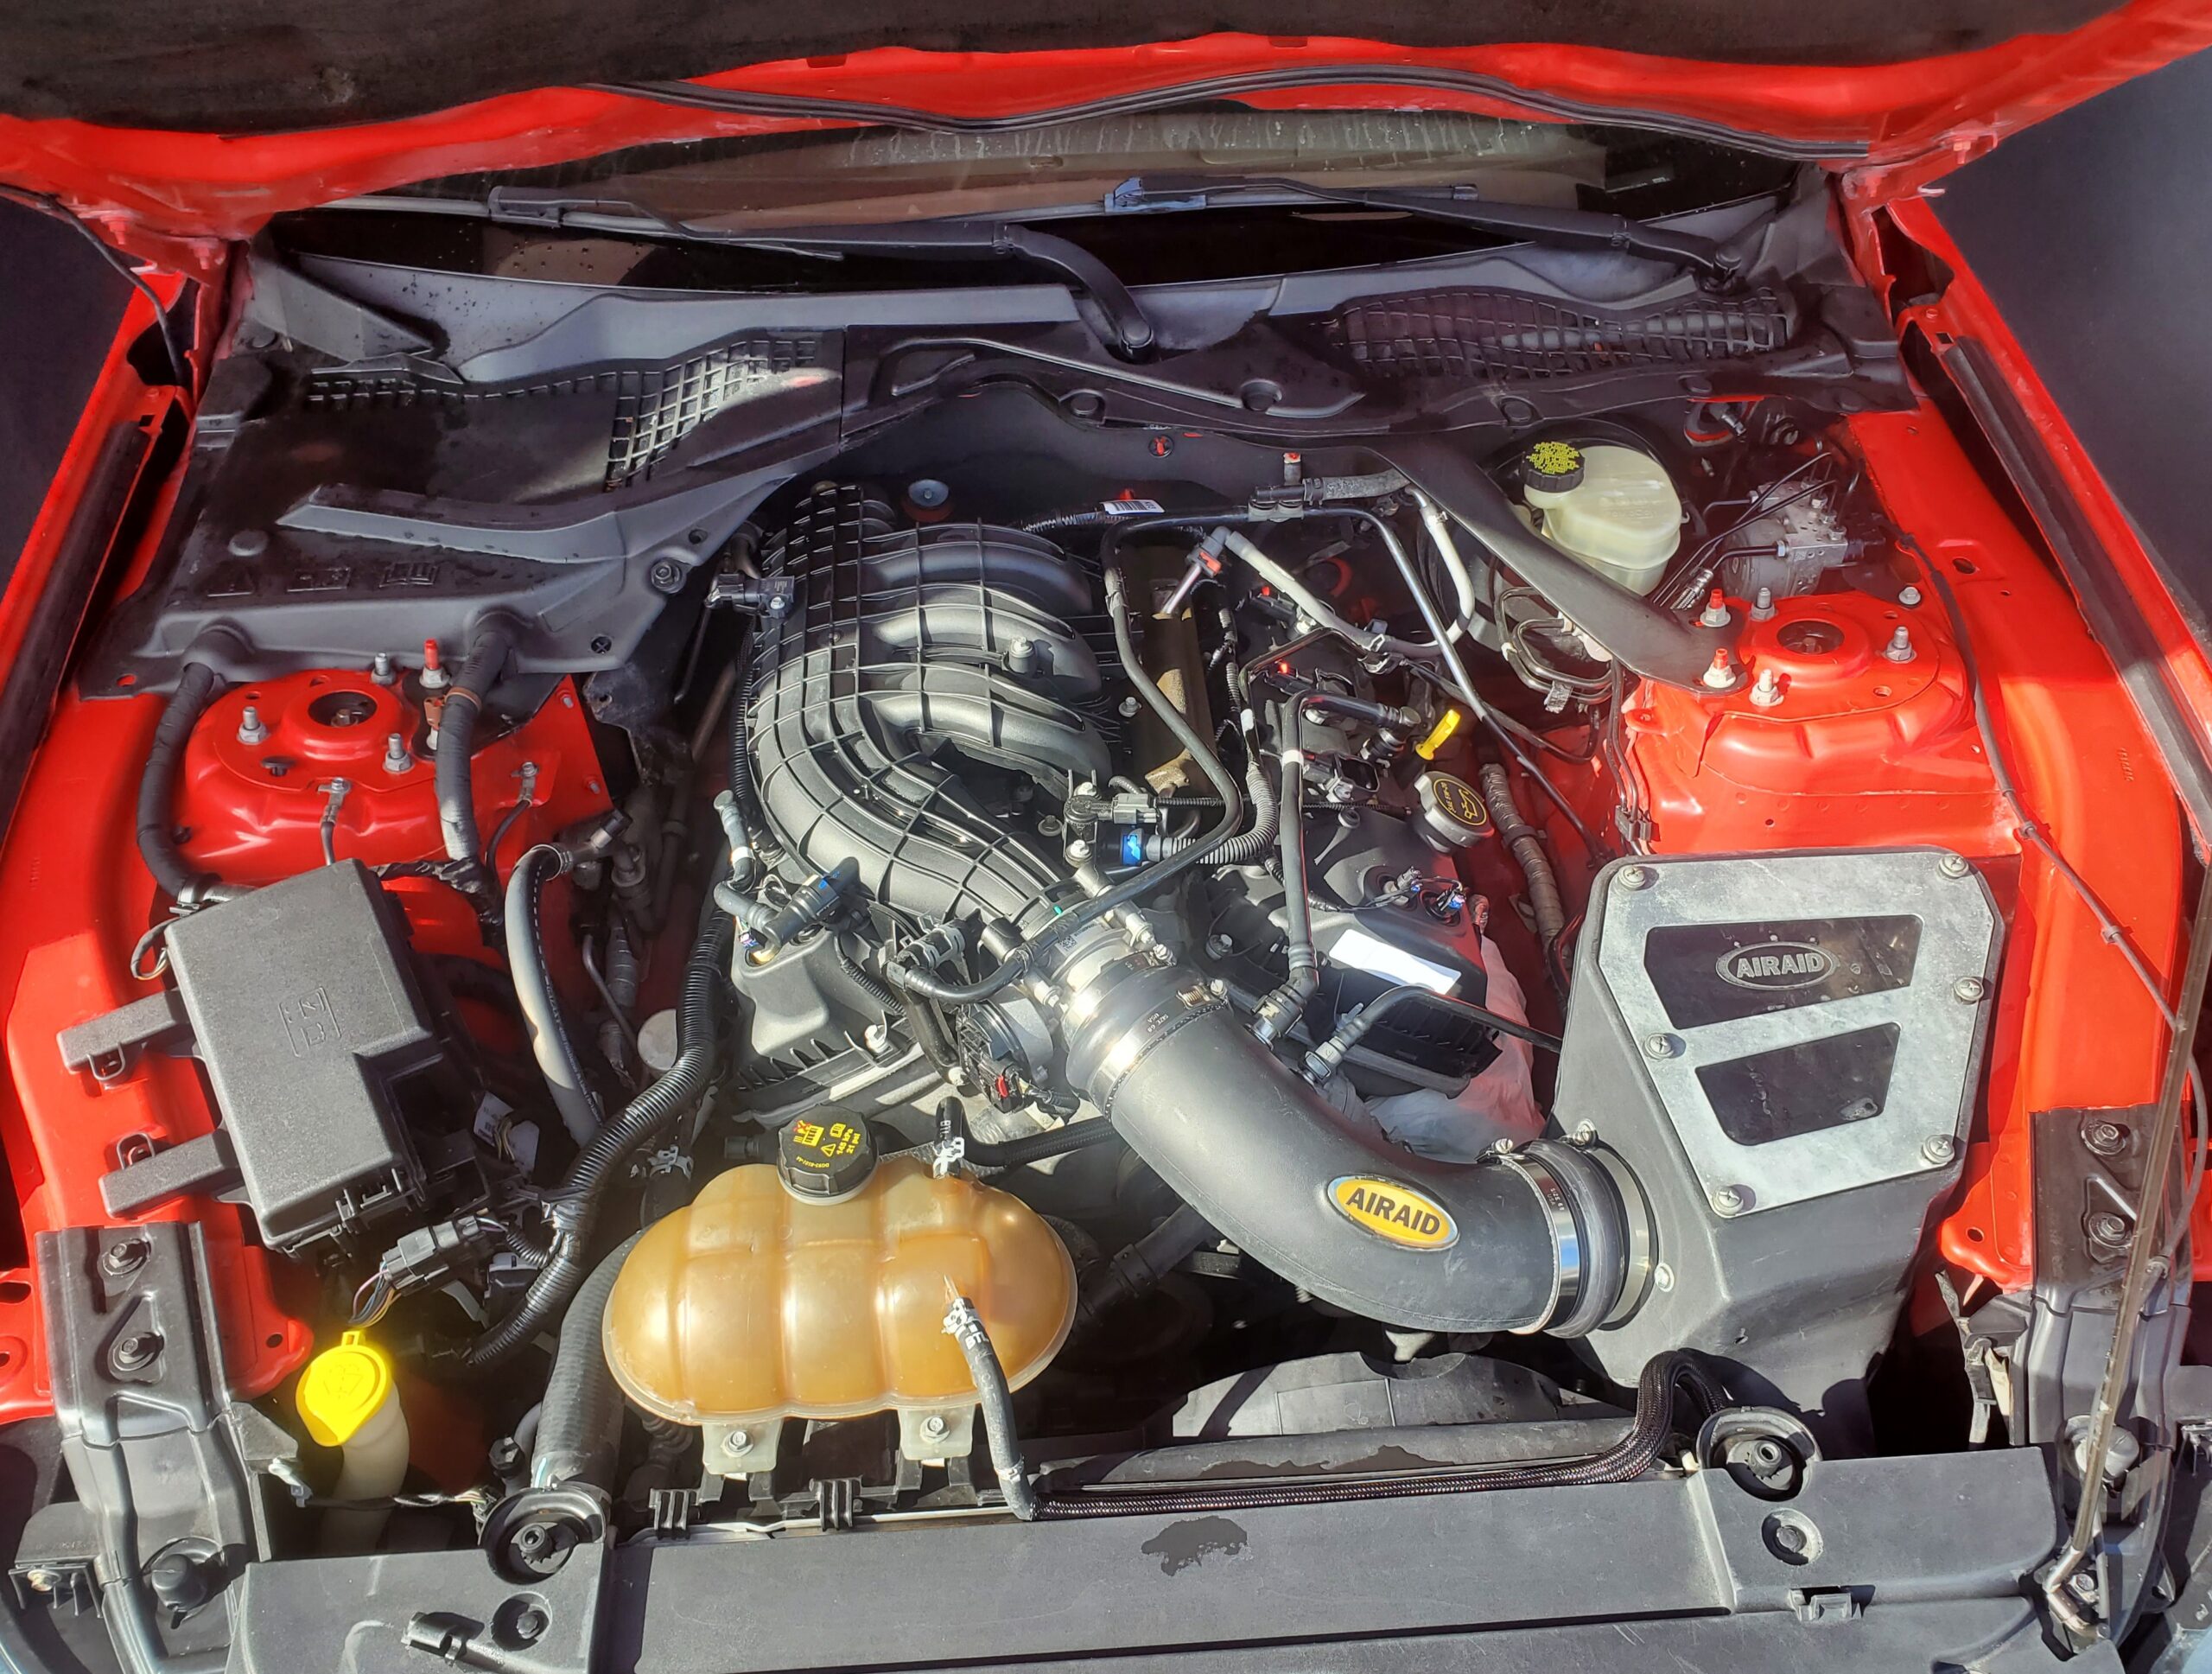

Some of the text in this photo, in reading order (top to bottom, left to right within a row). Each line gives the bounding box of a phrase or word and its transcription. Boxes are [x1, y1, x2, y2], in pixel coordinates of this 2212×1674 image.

[1736, 952, 1824, 978] AIRAID
[1147, 1013, 1160, 1023] USA
[836, 1128, 854, 1155] 145 kPa
[846, 1132, 861, 1155] 21 psi
[1345, 1187, 1440, 1235] AIRAID
